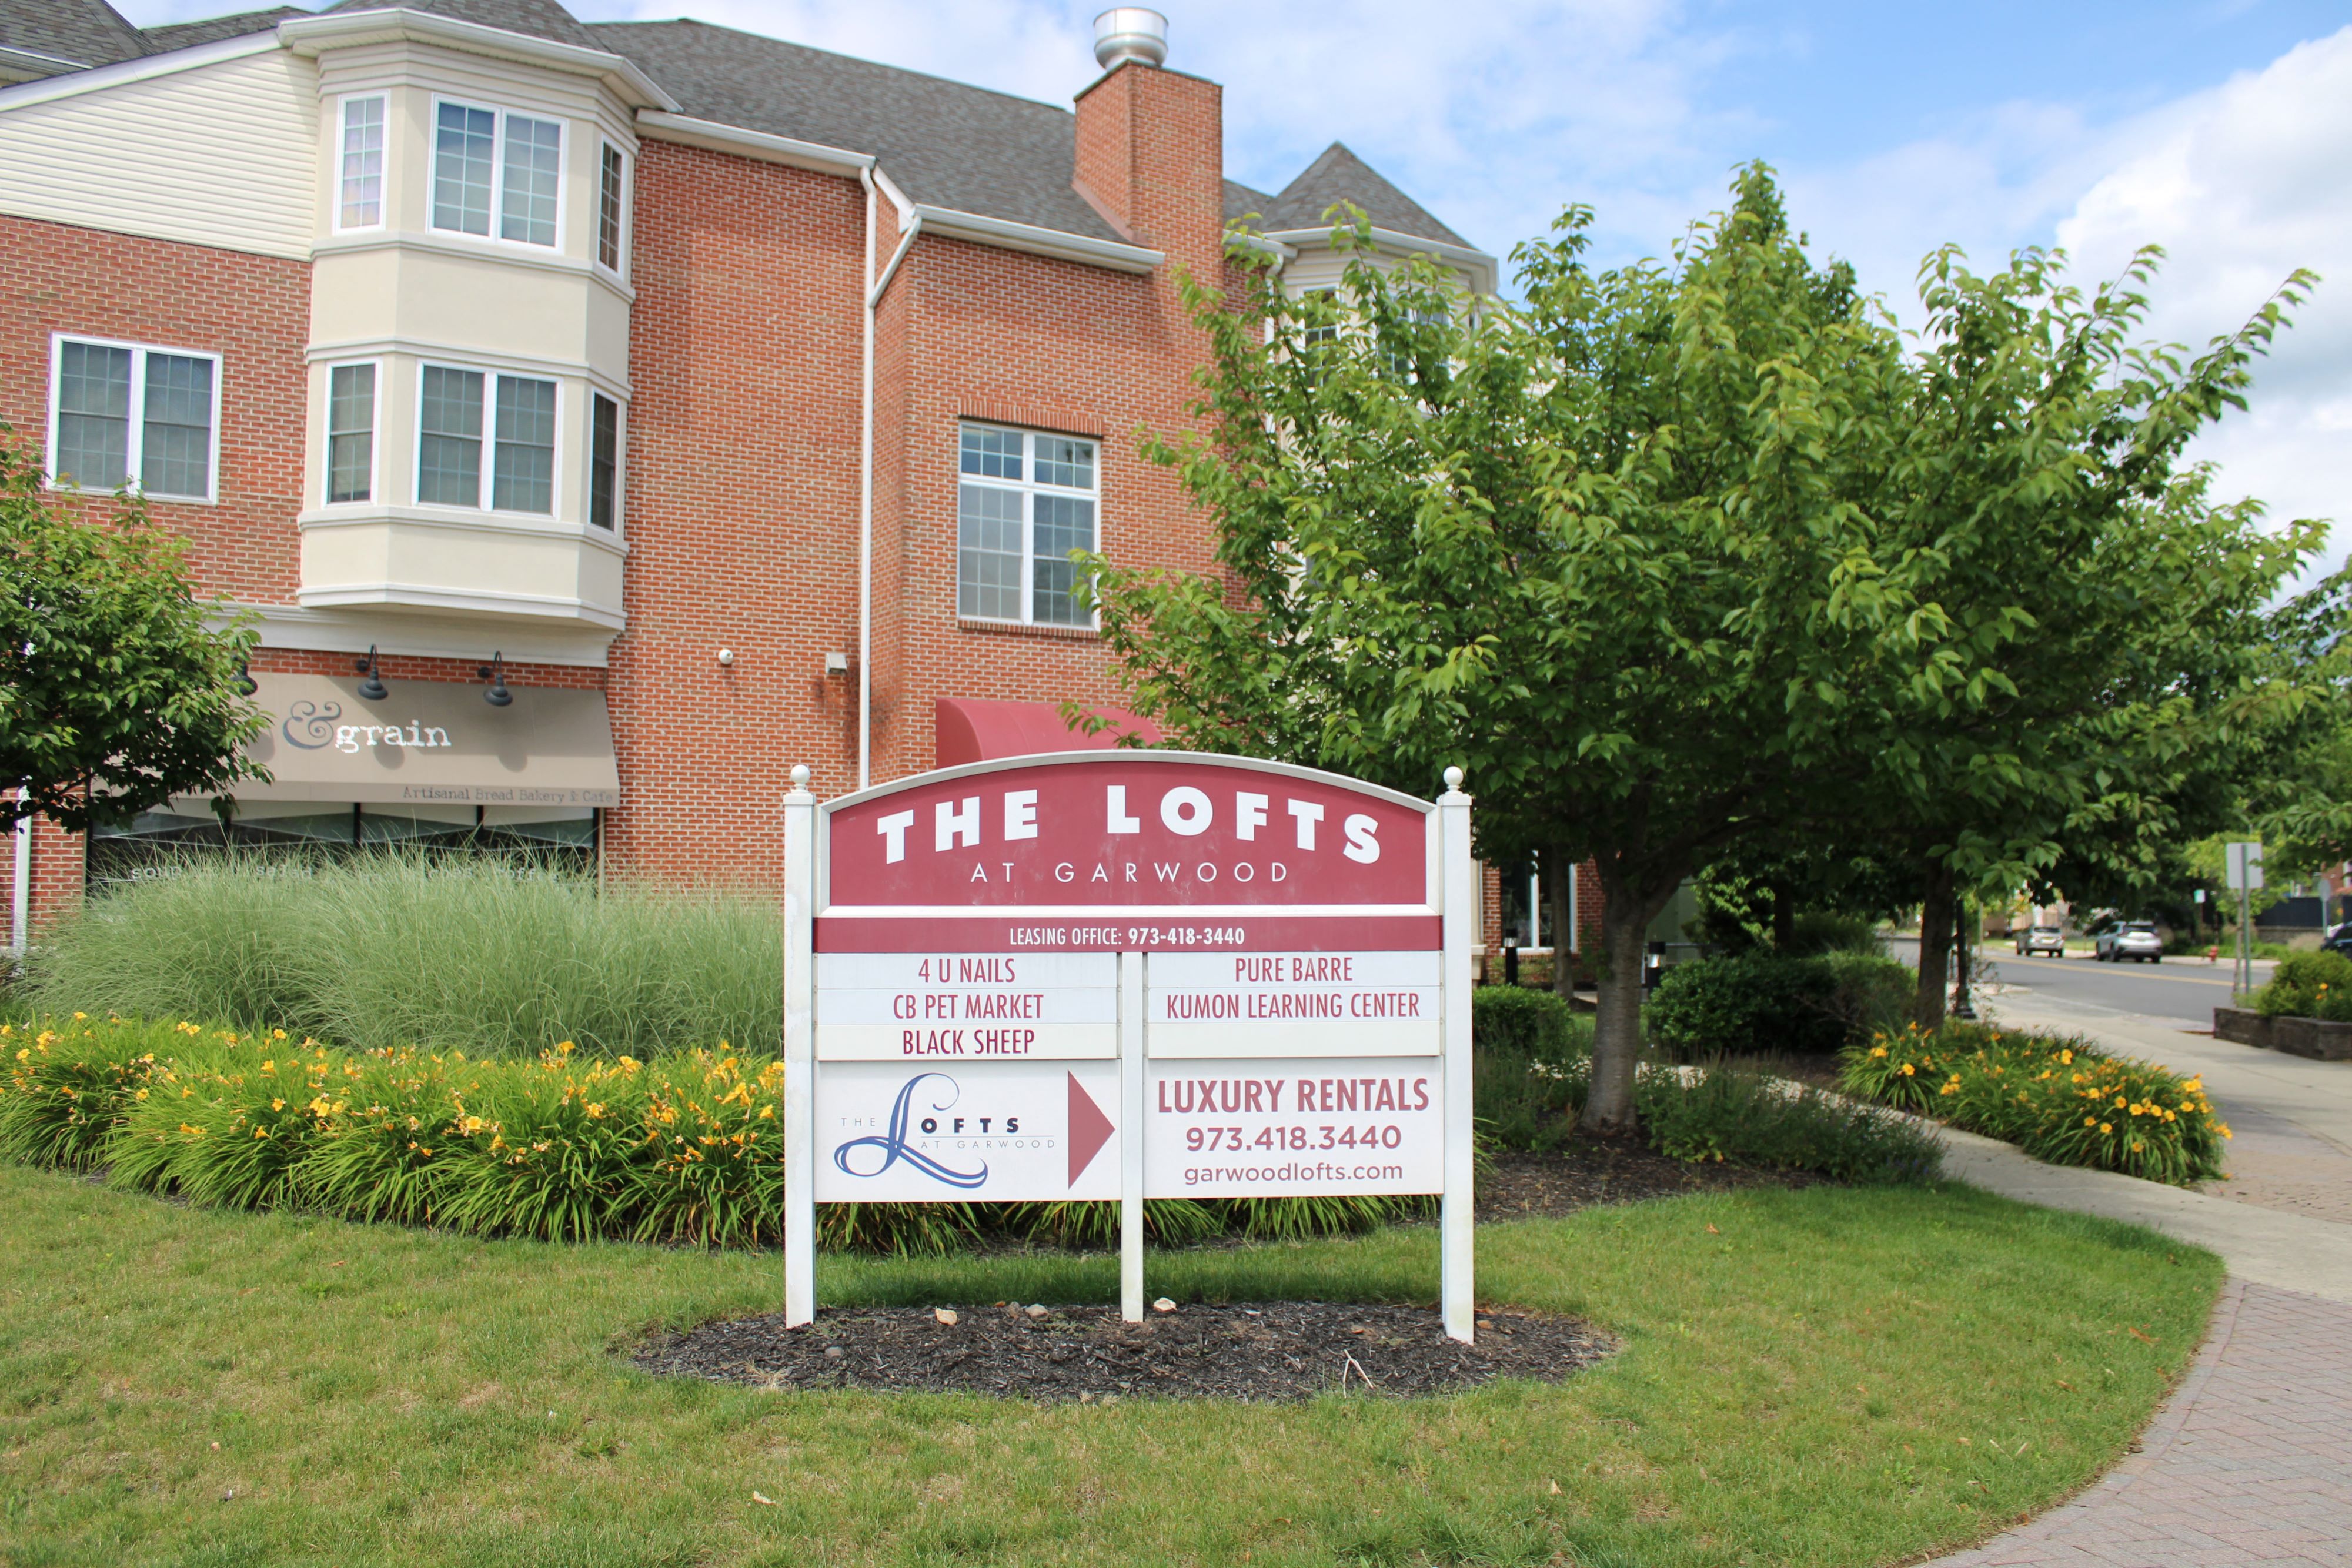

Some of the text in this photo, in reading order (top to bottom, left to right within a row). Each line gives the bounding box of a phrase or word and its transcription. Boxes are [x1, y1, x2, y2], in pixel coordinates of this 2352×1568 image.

[403, 786, 470, 800] Artisanal
[476, 787, 514, 801] Bread
[519, 788, 565, 803] Bakery
[877, 785, 1381, 864] THE LOFTS
[971, 862, 1287, 882] AT GARWOOD
[1010, 927, 1245, 945] LEASING OFFICE: 973-418-3440
[918, 958, 1015, 983] 4 U NAILS
[1235, 957, 1353, 982] PURE BARRE
[893, 994, 1044, 1019] CB PET MARKET
[1167, 992, 1419, 1019] KUMON LEARNING CENTER
[903, 1029, 1035, 1055] BLACK SHEEP
[1158, 1078, 1429, 1114] LUXURY RENTALS
[841, 1118, 876, 1126] THE
[921, 1139, 1055, 1149] AT GARWOOD
[1186, 1125, 1402, 1152] 973.418.3440
[1184, 1162, 1402, 1186] garwoodlofts.com
